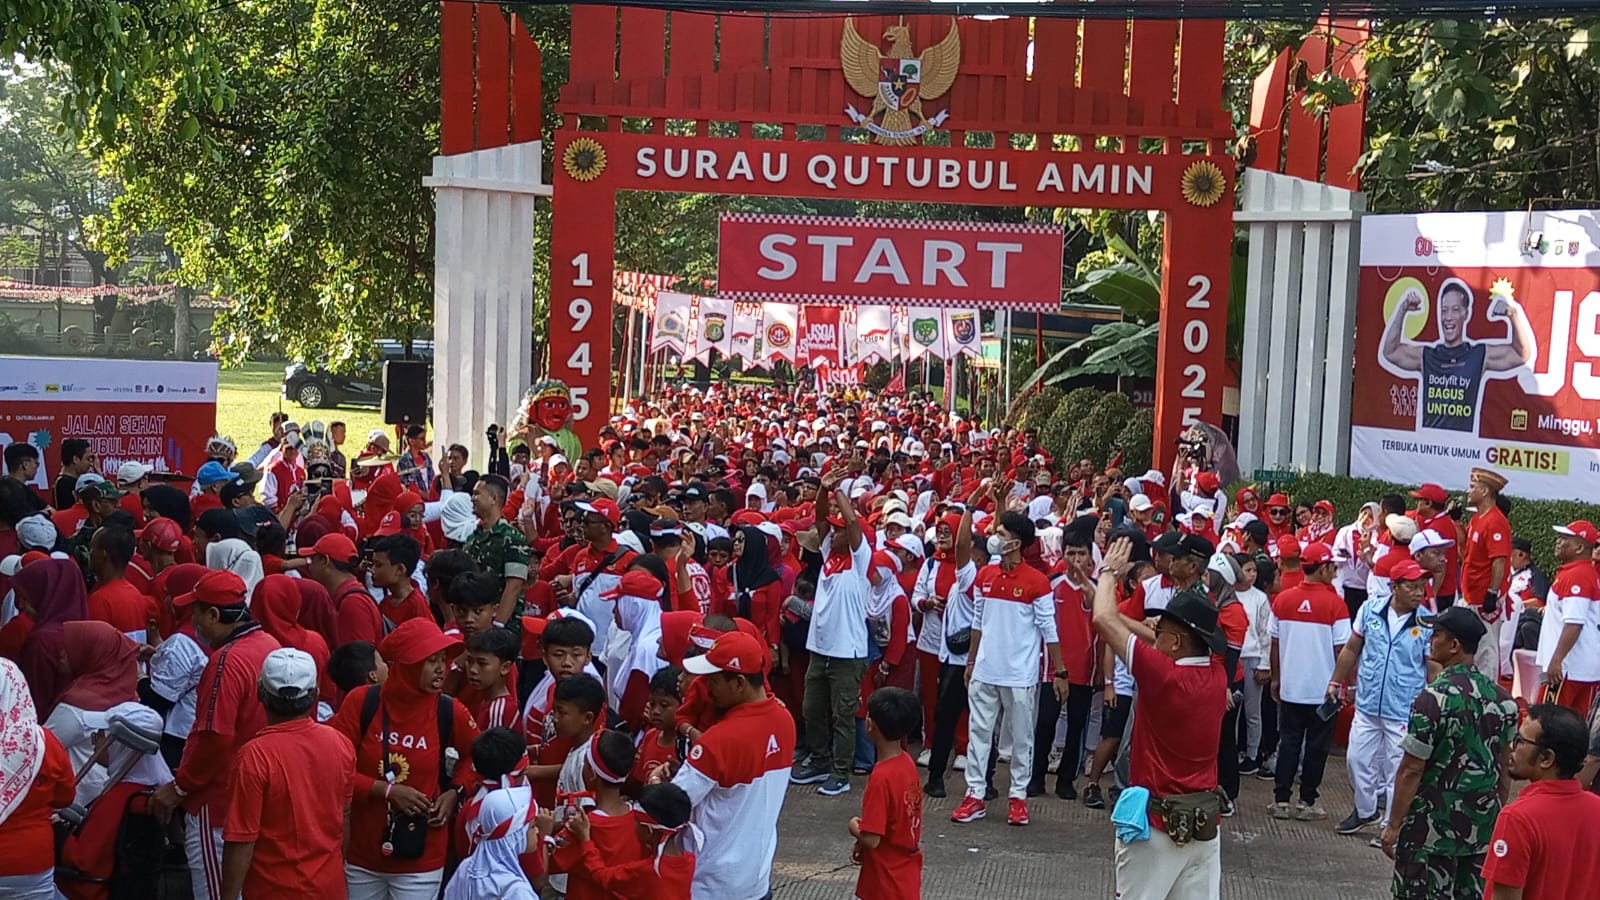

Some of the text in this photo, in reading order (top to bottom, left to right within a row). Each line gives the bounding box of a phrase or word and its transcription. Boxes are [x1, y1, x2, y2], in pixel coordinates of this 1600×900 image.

[636, 146, 1153, 196] SURAU QUTUBUL AMIN
[756, 233, 1023, 289] START
[567, 252, 593, 421] 1945
[1428, 374, 1471, 390] Bodyfit by
[1428, 386, 1465, 401] BAGUS
[1427, 401, 1472, 417] UNTORO
[61, 414, 167, 435] JALAN SEHAT
[1537, 414, 1593, 437] Minggu,
[128, 437, 163, 456] AMIN
[1381, 439, 1418, 454] TERBUKA
[1420, 444, 1450, 456] UNTUK
[1451, 448, 1481, 460] UMUM
[1485, 446, 1557, 471] GRATIS!
